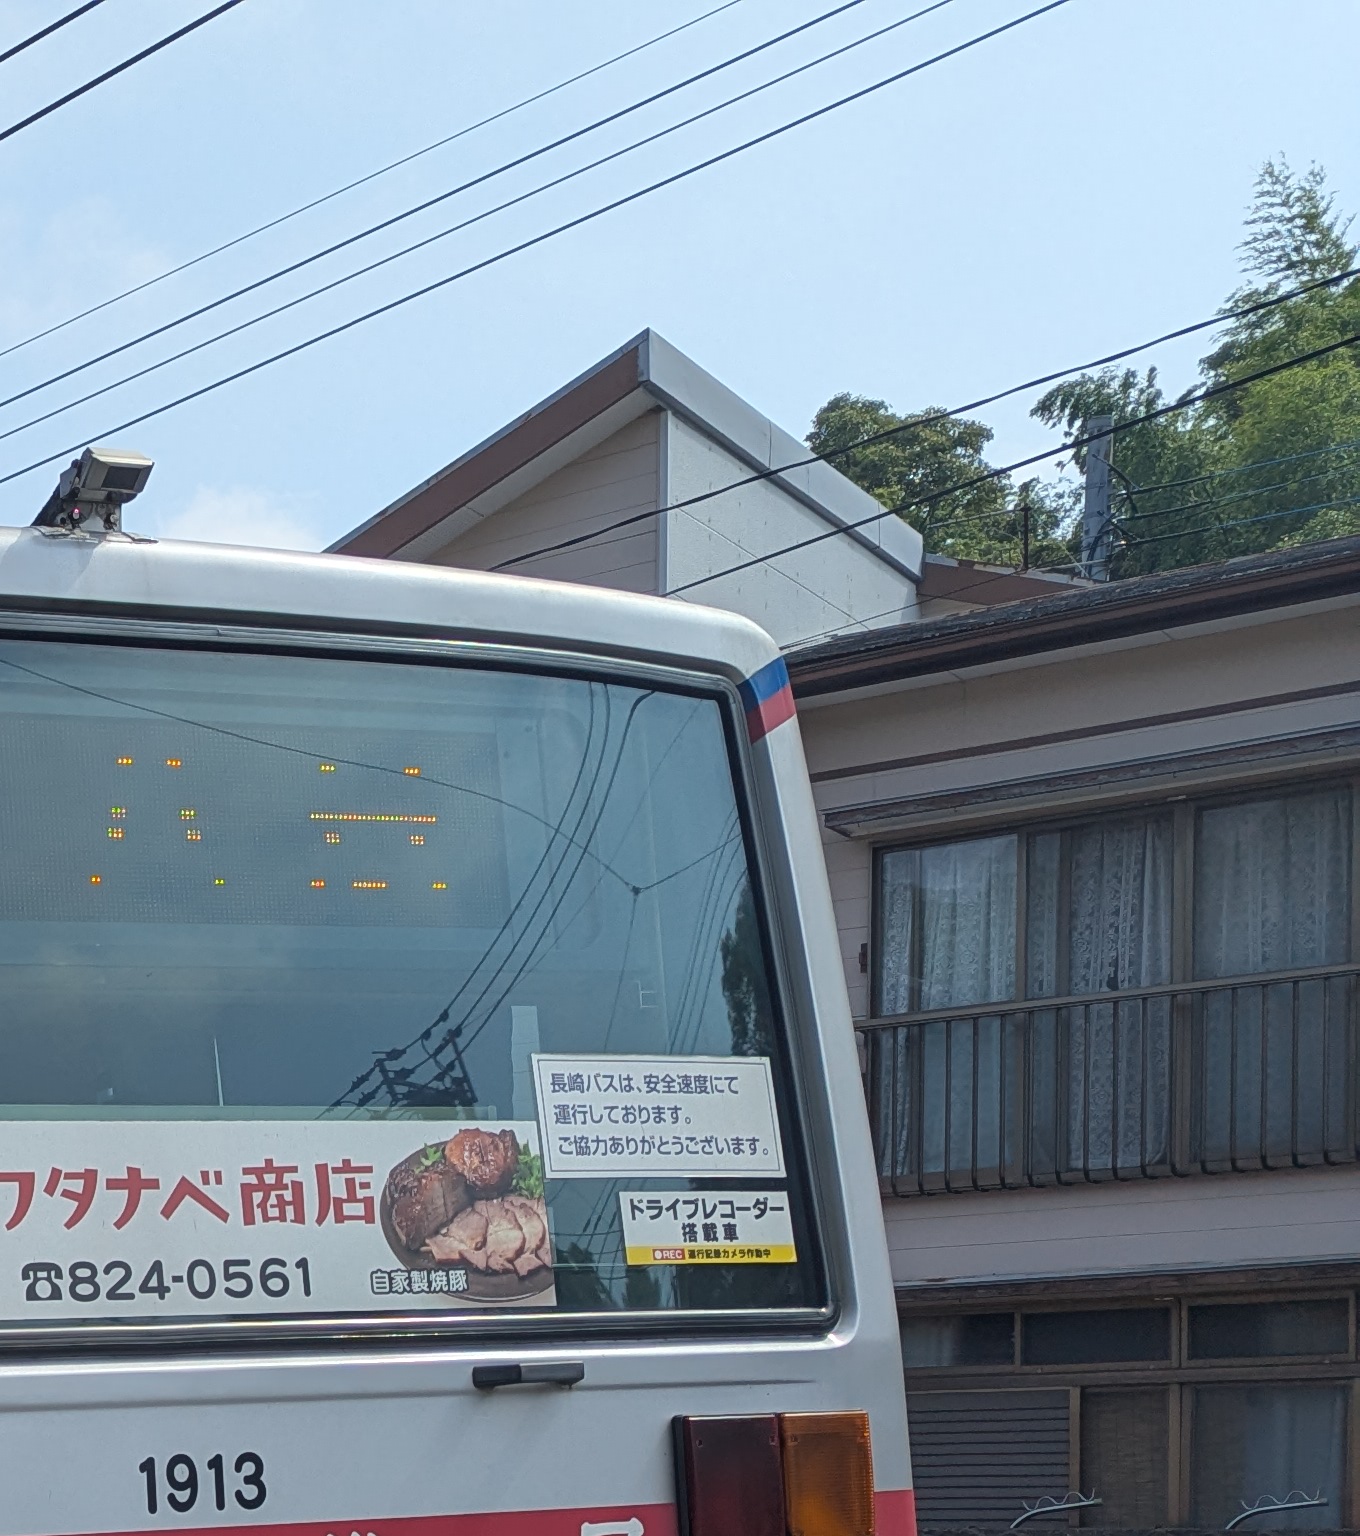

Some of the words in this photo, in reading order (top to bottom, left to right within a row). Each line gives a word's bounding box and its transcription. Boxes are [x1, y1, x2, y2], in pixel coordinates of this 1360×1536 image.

[550, 1073, 739, 1095] 長崎バスは、安全速度にて
[553, 1104, 692, 1126] 運行しております。
[558, 1135, 769, 1157] ご協力ありがとうございます。
[628, 1196, 785, 1221] ドライブレコーダー
[681, 1221, 739, 1244] 搭載車
[68, 1257, 311, 1303] 824-0561
[371, 1268, 468, 1295] 自家製焼豚
[138, 1451, 268, 1514] 1913
